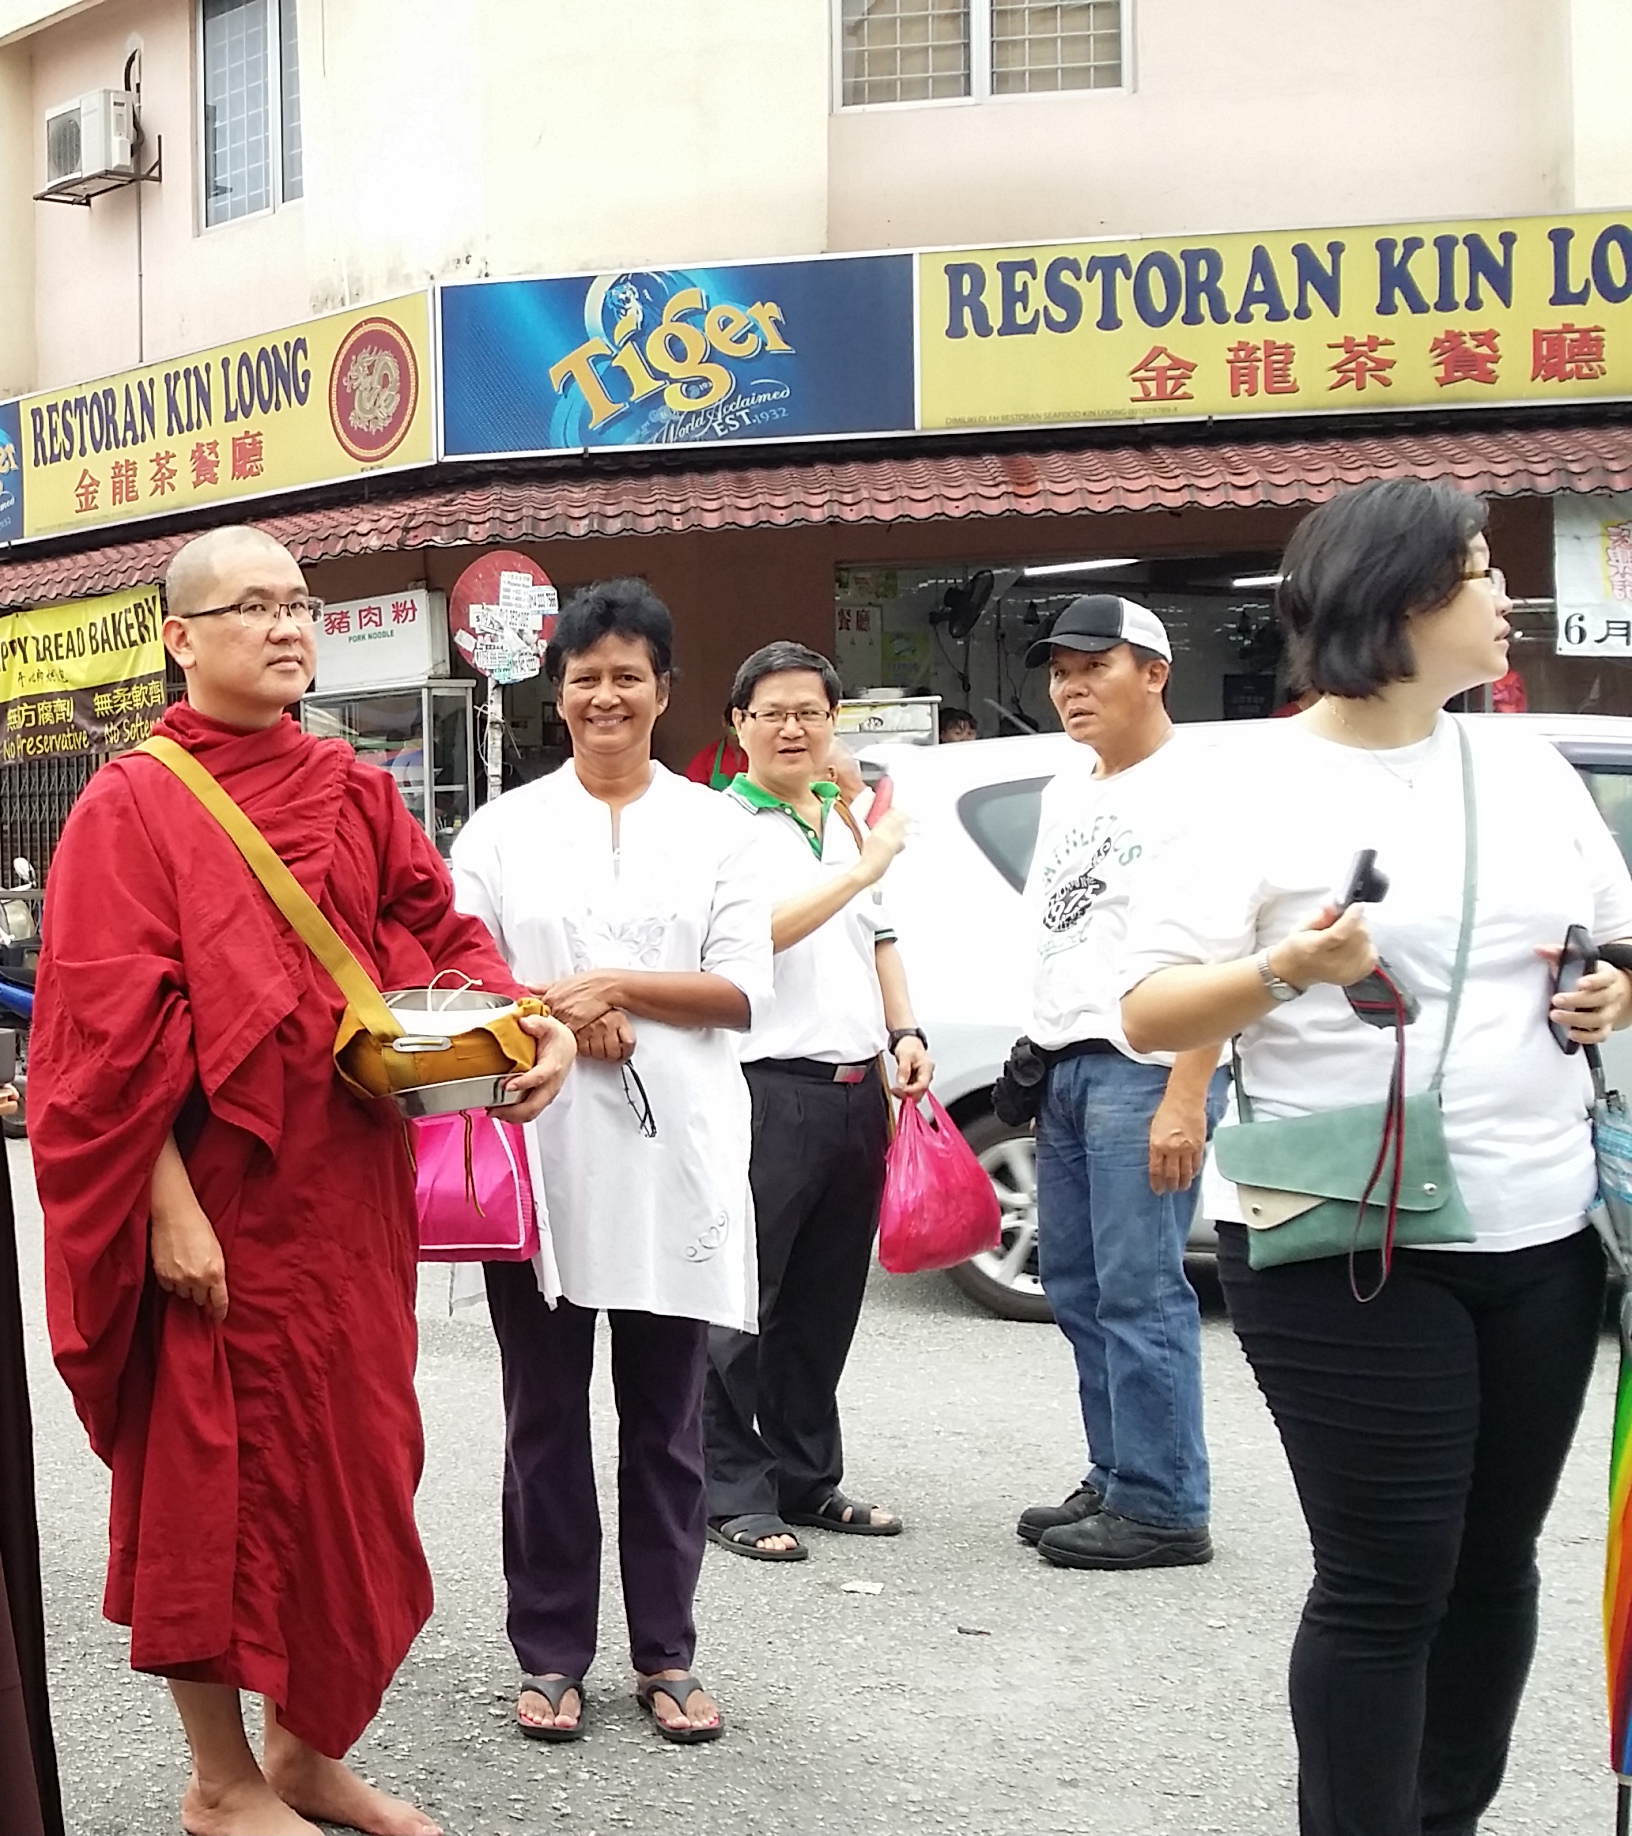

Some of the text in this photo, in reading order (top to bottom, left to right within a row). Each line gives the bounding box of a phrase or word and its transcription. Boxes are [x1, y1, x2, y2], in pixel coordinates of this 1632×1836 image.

[944, 223, 1632, 339] RESTORAN KIN LO
[549, 287, 795, 430] Tiger
[1128, 323, 1607, 404] 金龍茶餐廳
[31, 336, 311, 468] RESTORAN KIN LOONG
[654, 409, 706, 443] World
[701, 380, 792, 425] Acclaimed
[712, 406, 788, 438] EST. 1932
[1000, 412, 1042, 423] RESTORAN
[1043, 410, 1081, 420] SEAFOOD
[1082, 409, 1097, 418] KIN
[74, 430, 264, 514] 金龍茶餐廳
[88, 594, 158, 656] BAKERY
[324, 598, 418, 636] 豬肉粉
[348, 629, 395, 643] PORK NOODLE
[3, 738, 16, 761] No
[104, 721, 120, 746] No
